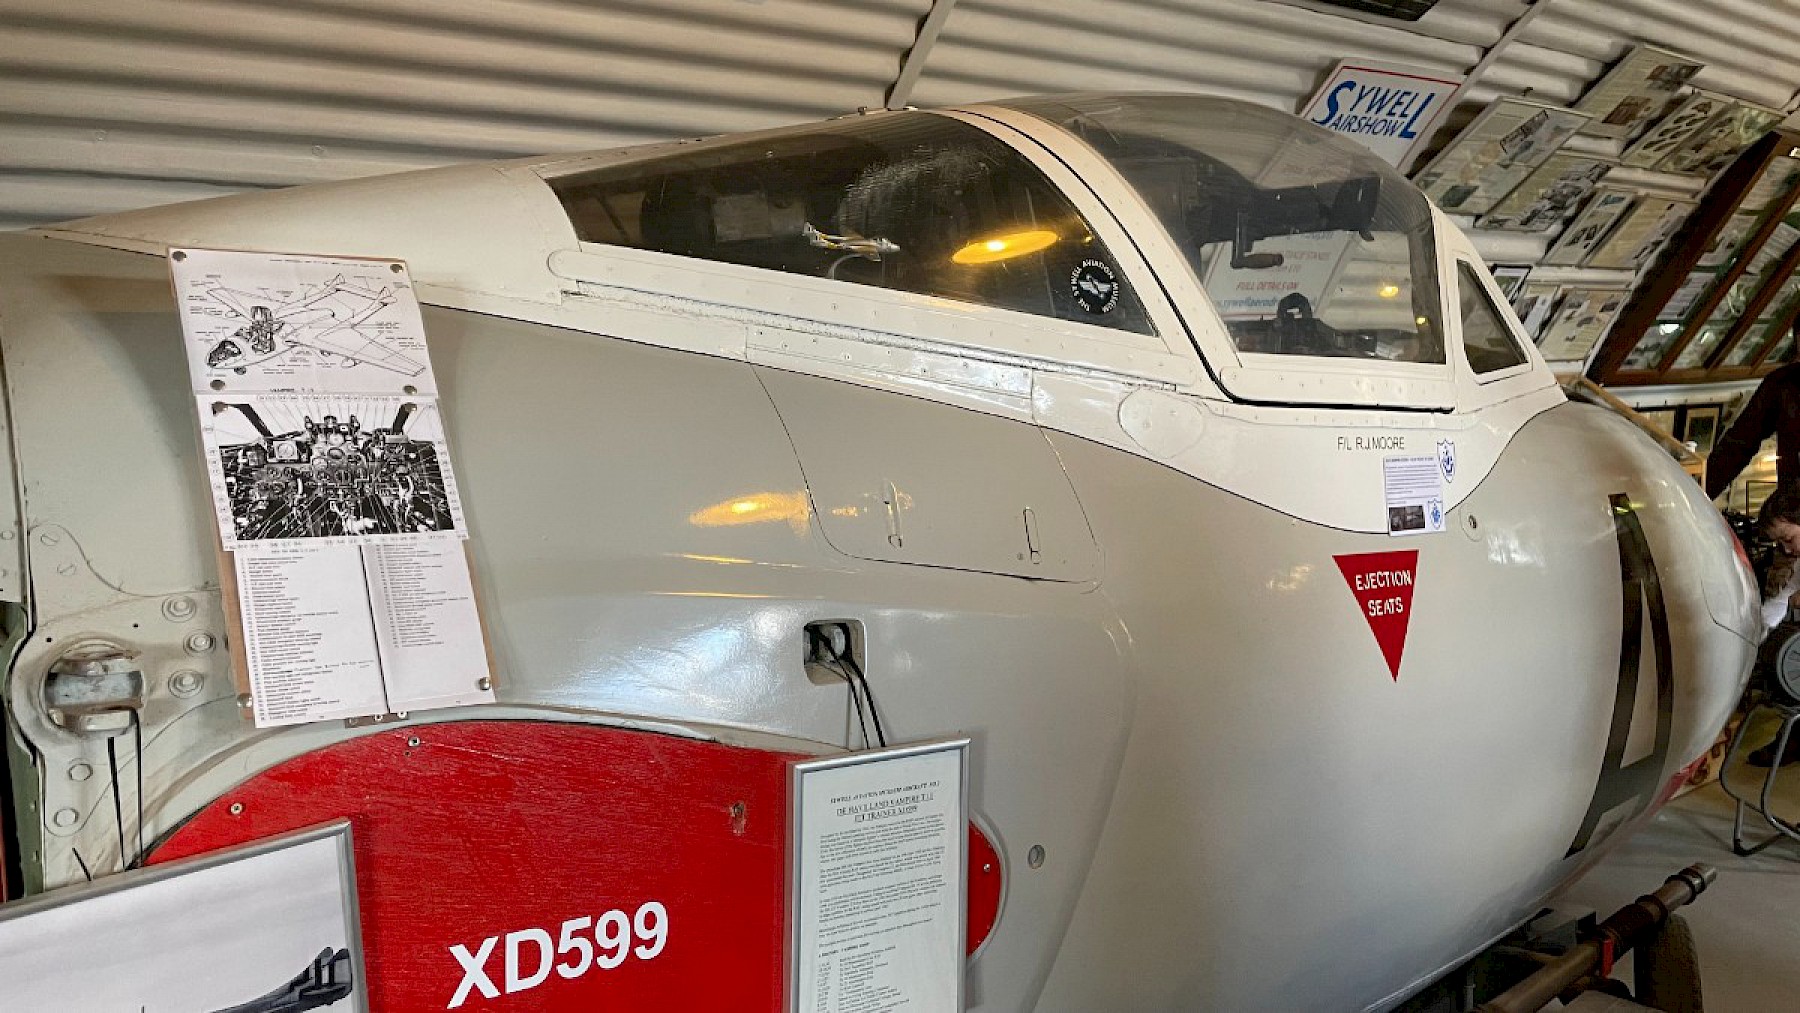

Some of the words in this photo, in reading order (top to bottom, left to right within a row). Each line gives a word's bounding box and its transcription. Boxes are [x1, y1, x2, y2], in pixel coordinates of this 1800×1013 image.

[1312, 80, 1435, 138] SYWELL
[1330, 113, 1404, 136] AIRSHOW
[1337, 437, 1352, 450] F/L
[1355, 569, 1412, 591] EJECTION
[1367, 596, 1404, 617] SEATS
[446, 901, 669, 1010] XD599
